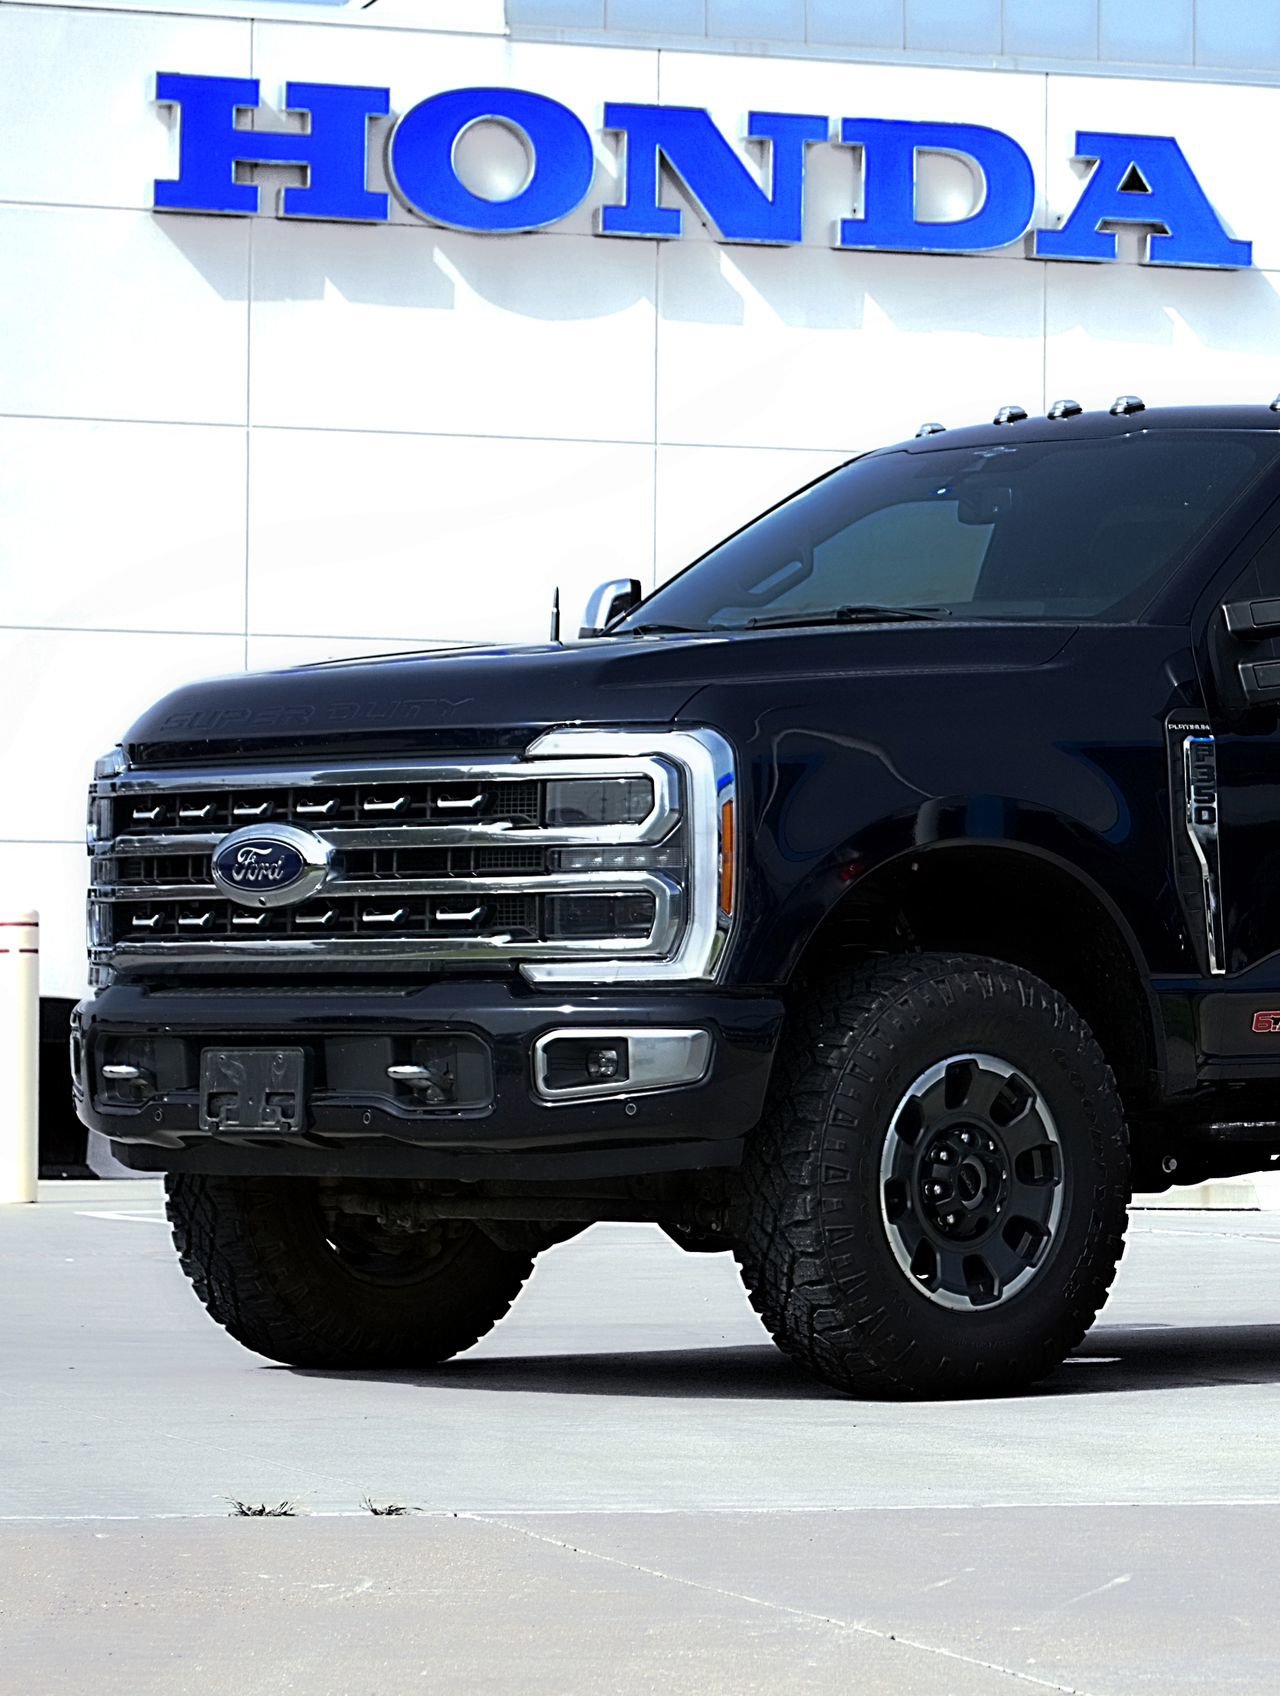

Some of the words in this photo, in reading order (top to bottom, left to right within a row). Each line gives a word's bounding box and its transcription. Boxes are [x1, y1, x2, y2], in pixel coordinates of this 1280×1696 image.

[153, 71, 1254, 269] HONDA
[160, 704, 316, 731] SUPER
[328, 698, 475, 720] DUTY
[231, 846, 285, 881] Ford
